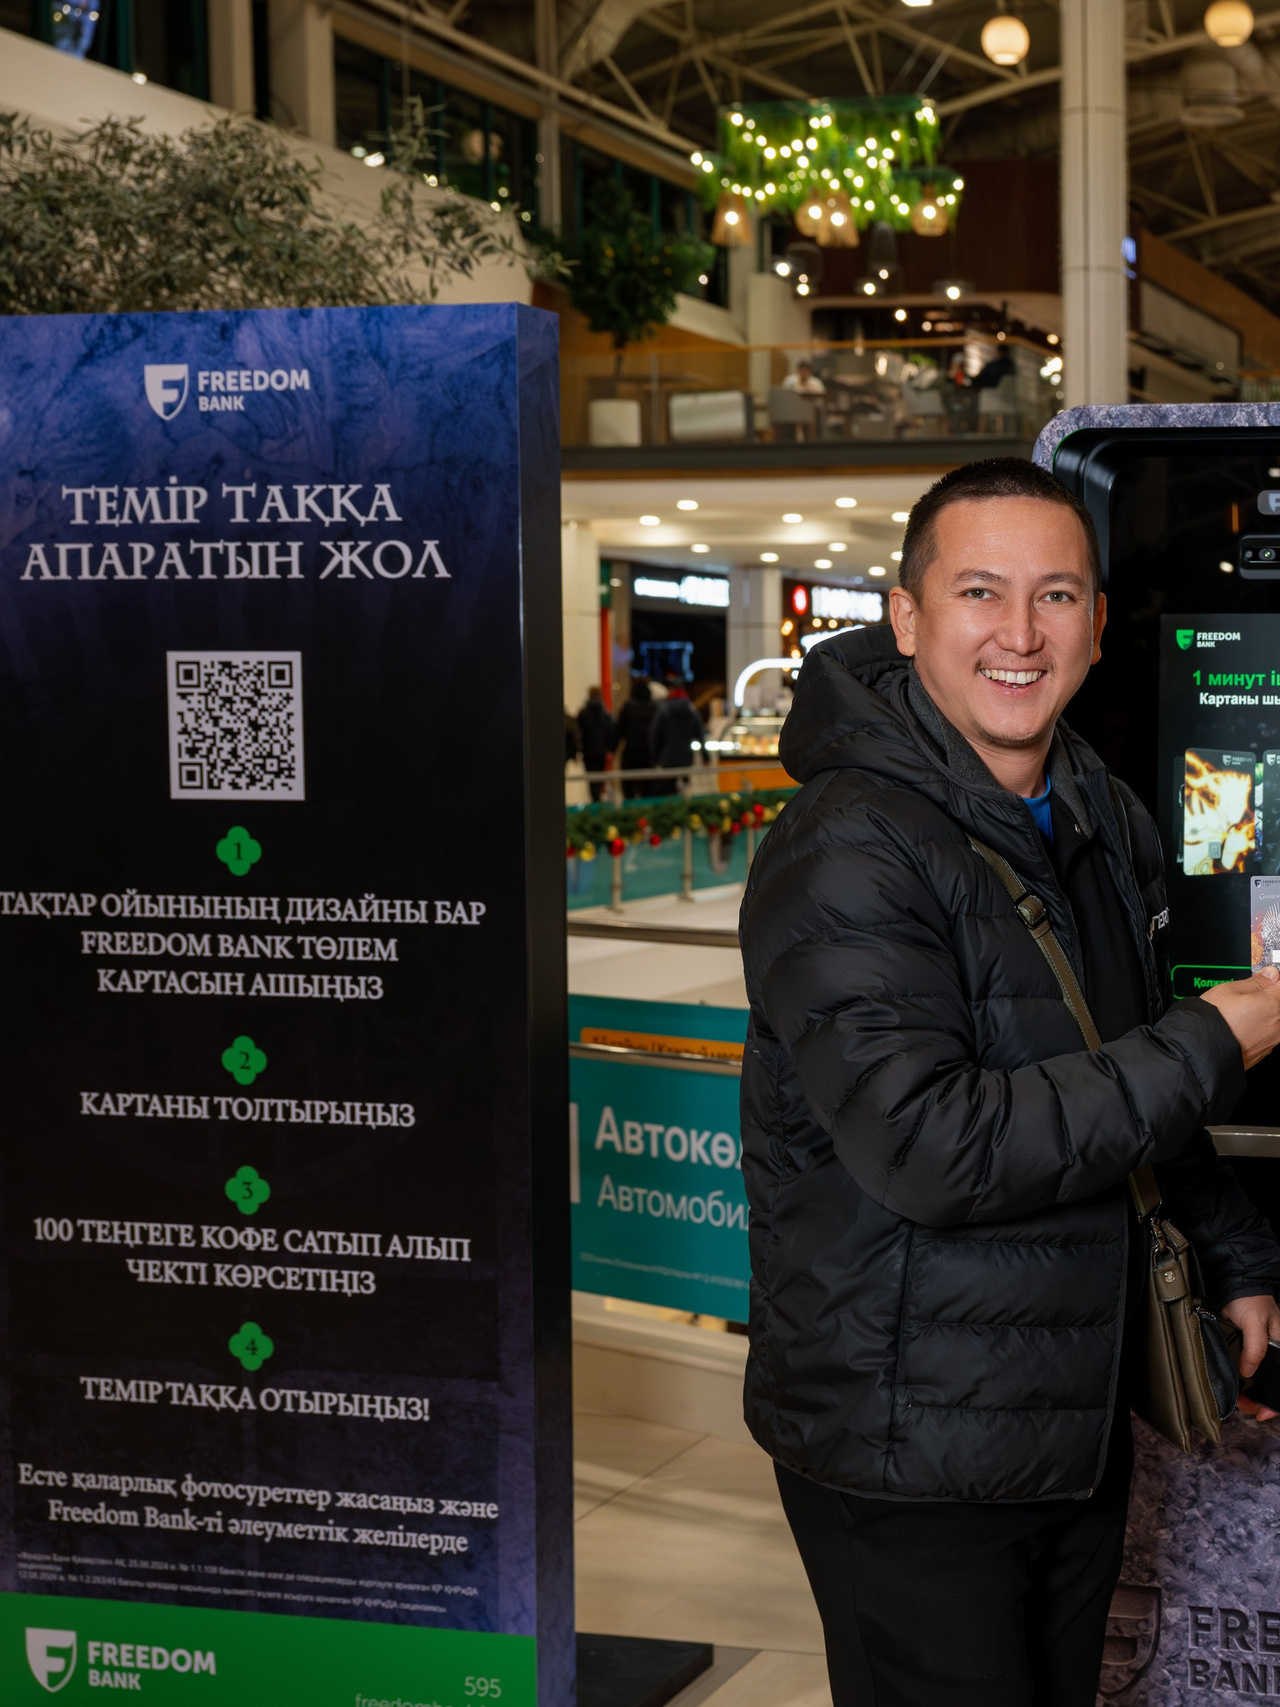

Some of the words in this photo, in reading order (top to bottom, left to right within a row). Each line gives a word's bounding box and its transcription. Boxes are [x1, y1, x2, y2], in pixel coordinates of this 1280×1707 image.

[197, 368, 311, 393] FREEDOM
[198, 394, 246, 413] BANK
[222, 482, 402, 527] ТАҚҚА
[19, 537, 305, 581] АПАРАТЫН
[319, 539, 452, 579] ЖОЛ
[1197, 632, 1241, 641] FREEDOM
[1192, 669, 1201, 686] 1
[1208, 674, 1266, 690] минут
[1199, 692, 1259, 708] Картаны
[233, 842, 245, 861] 1
[0, 891, 97, 919] ТАҚТАР
[101, 889, 279, 924] ОЙЫНЫНЫҢ
[285, 894, 428, 924] ДИЗАЙНЫ
[434, 902, 486, 925] БАР
[81, 931, 212, 957] FREEDOM
[218, 935, 294, 960] BANK
[298, 937, 399, 962] ТӨЛЕМ
[98, 968, 246, 996] КАРТАСЫН
[250, 973, 384, 1002] АШЫҢЫЗ
[238, 1052, 250, 1070] 2
[80, 1092, 209, 1119] КАРТАНЫ
[213, 1096, 416, 1129] ТОЛТЫРЫҢЫЗ
[241, 1181, 253, 1200] 3
[34, 1217, 73, 1241] 100
[77, 1219, 196, 1250] ТЕҢГЕГЕ
[200, 1226, 279, 1253] КОФЕ
[283, 1230, 382, 1256] САТЫП
[385, 1236, 471, 1261] АЛЫП
[125, 1257, 208, 1286] ЧЕКТІ
[213, 1263, 377, 1297] КӨРСЕТІҢІЗ
[244, 1336, 258, 1355] 4
[80, 1376, 165, 1402] ТЕМІР
[166, 1383, 257, 1413] ТАҚҚА
[259, 1388, 431, 1423] ОТЫРЫҢЫЗ!
[18, 1463, 68, 1488] Есте
[72, 1470, 177, 1498] қаларлық
[181, 1474, 331, 1513] фотосуреттер
[336, 1488, 435, 1515] жасаңыз
[440, 1498, 499, 1520] және
[49, 1500, 140, 1527] Freedom
[144, 1509, 224, 1534] Bank-ті
[228, 1513, 349, 1546] әлеуметтік
[353, 1525, 469, 1556] желілерде
[87, 1640, 217, 1676] FREEDOM
[87, 1668, 142, 1691] BANK
[464, 1676, 502, 1698] 595
